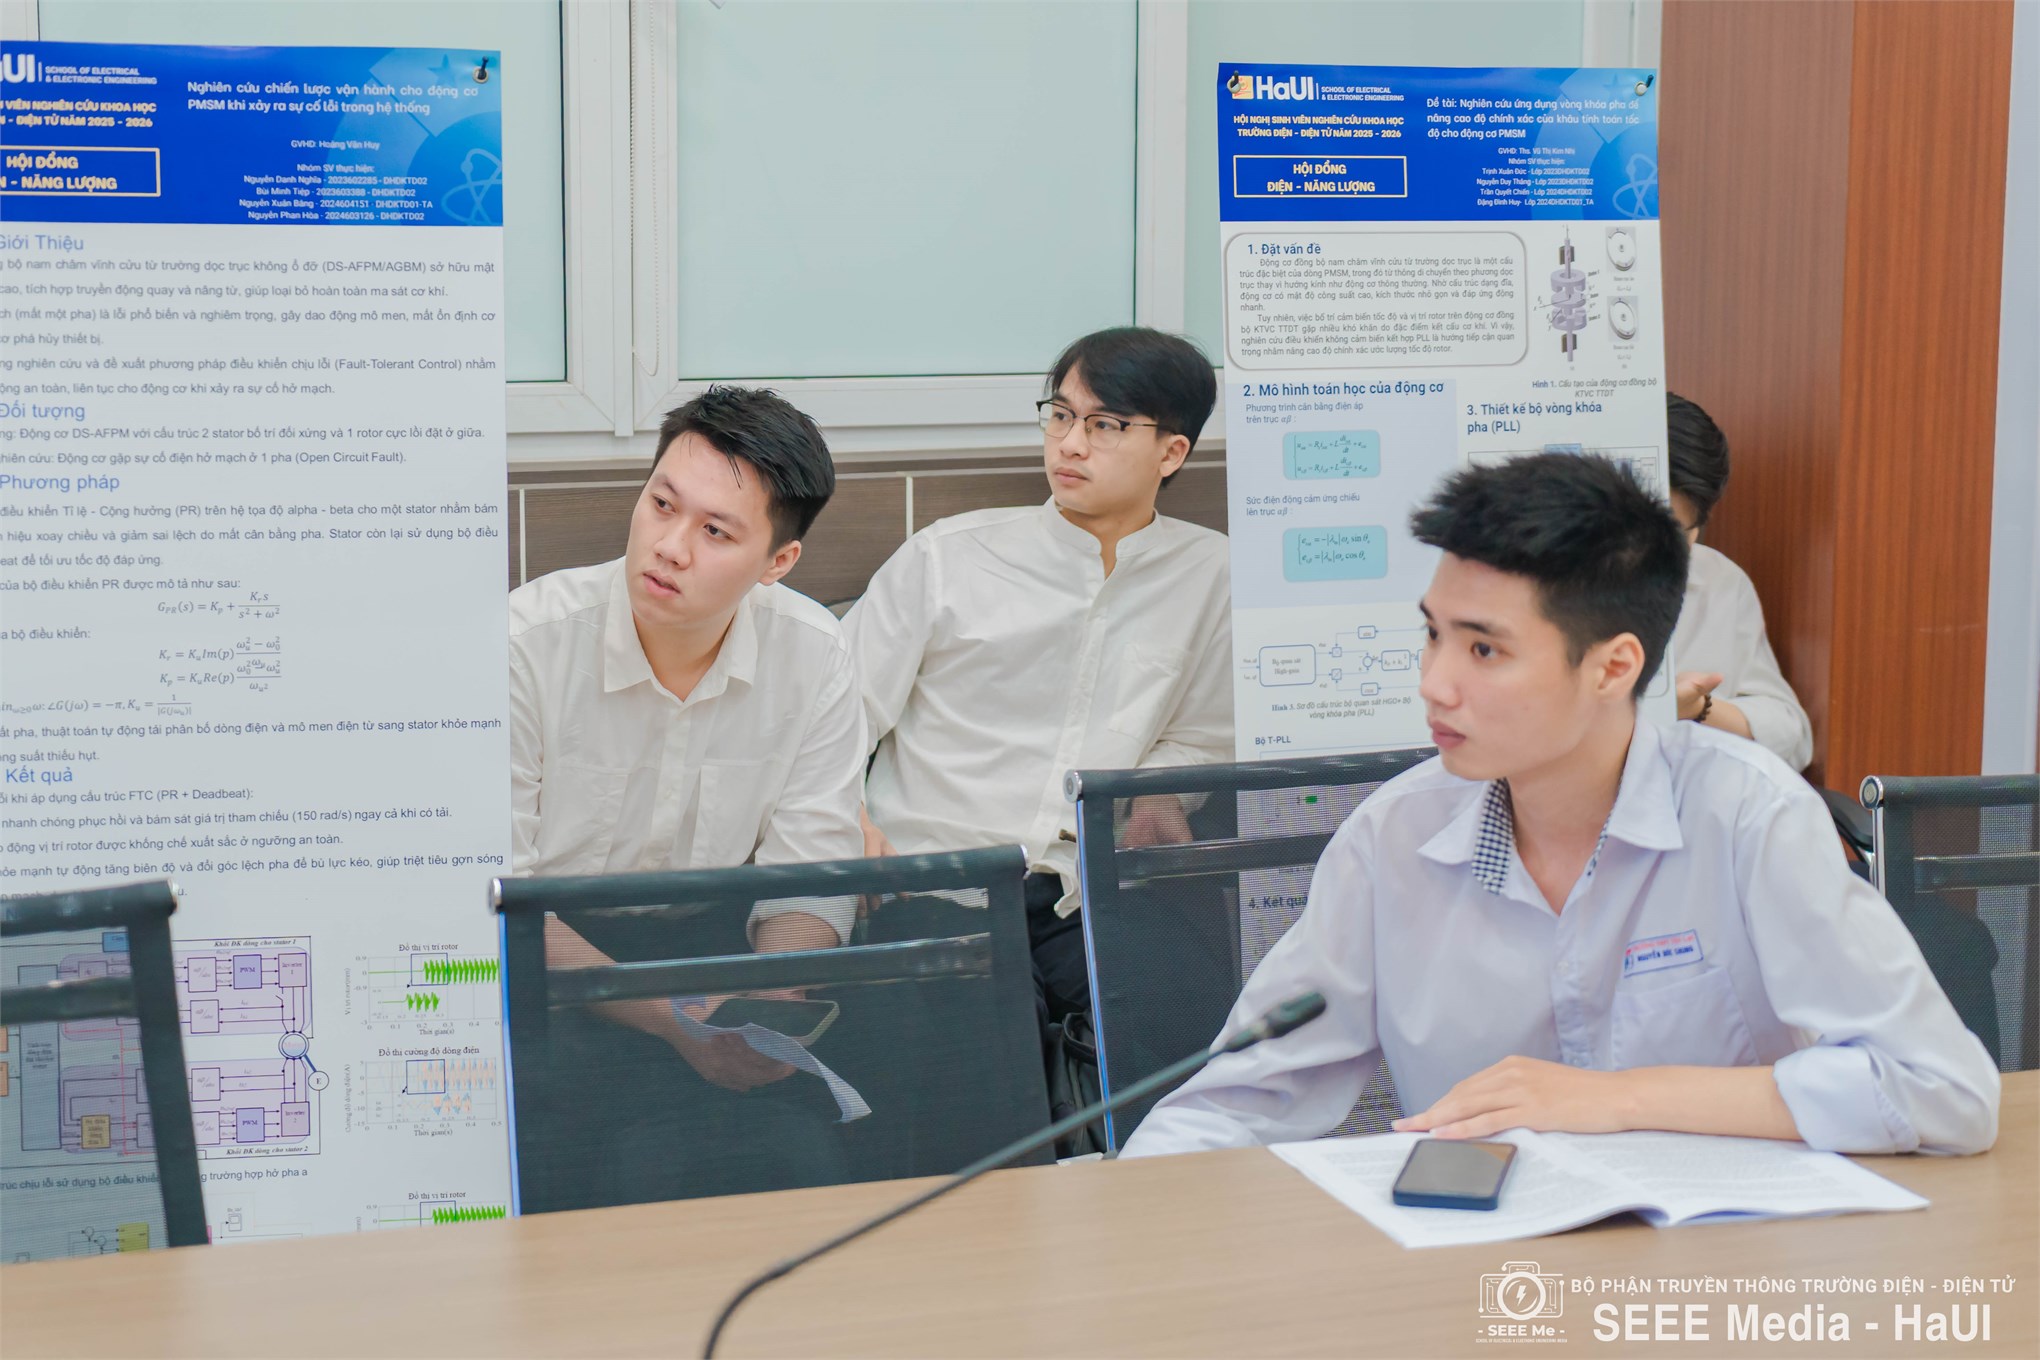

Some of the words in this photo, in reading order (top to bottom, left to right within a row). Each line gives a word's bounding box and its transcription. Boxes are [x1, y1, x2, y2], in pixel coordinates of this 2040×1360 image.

[0, 54, 34, 82] UI
[187, 81, 232, 94] Nghiên
[236, 81, 260, 93] cứu
[264, 80, 299, 93] chiến
[303, 83, 330, 96] lược
[336, 83, 359, 97] vận
[363, 84, 394, 95] hành
[400, 84, 422, 95] cho
[427, 85, 458, 98] động
[463, 87, 478, 96] cơ
[1256, 75, 1313, 100] HaUI
[5, 98, 31, 109] VIÊN
[31, 99, 73, 110] NGHIÊN
[74, 98, 99, 111] CỨU
[99, 102, 131, 112] KHOA
[132, 102, 156, 114] HỌC
[188, 98, 225, 110] PMSM
[227, 99, 245, 110] khi
[248, 99, 270, 113] xảy
[273, 102, 286, 111] ra
[288, 102, 304, 113] sự
[305, 98, 320, 111] cố
[323, 99, 338, 111] lỗi
[341, 102, 374, 114] trong
[376, 101, 392, 114] hệ
[394, 101, 430, 115] thống
[1426, 96, 1439, 107] Đề
[1441, 98, 1456, 107] tài:
[1459, 98, 1492, 110] Nghiên
[1494, 98, 1512, 108] cứu
[1514, 98, 1532, 110] ứng
[1533, 99, 1557, 110] dụng
[1560, 101, 1582, 110] vòng
[1584, 99, 1606, 108] khóa
[1608, 99, 1625, 110] pha
[1628, 98, 1638, 109] để
[16, 113, 42, 127] ĐIỆN
[44, 113, 59, 125] TỬ
[60, 114, 86, 125] NĂM
[87, 116, 115, 126] 2025
[125, 117, 152, 127] 2026
[1233, 114, 1248, 125] HỘI
[1249, 115, 1270, 125] NGHỊ
[1271, 115, 1291, 123] SINH
[1292, 114, 1311, 124] VIÊN
[1312, 114, 1343, 124] NGHIÊN
[1343, 114, 1361, 124] CỨU
[1362, 116, 1385, 124] KHOA
[1386, 116, 1404, 126] HỌC
[1427, 113, 1451, 124] nâng
[1473, 113, 1486, 124] độ
[1488, 113, 1514, 122] chính
[1517, 113, 1534, 123] xác
[1536, 114, 1553, 123] của
[1556, 114, 1578, 123] khâu
[1582, 114, 1599, 123] tính
[1602, 114, 1622, 123] toán
[1625, 113, 1639, 124] tốc
[1237, 126, 1272, 136] TRƯỜNG
[1273, 127, 1292, 138] ĐIỆN
[1300, 127, 1319, 139] ĐIỆN
[1320, 127, 1332, 137] TỬ
[1332, 127, 1352, 137] NĂM
[1353, 129, 1373, 137] 2025
[1381, 129, 1401, 137] 2026
[1427, 128, 1440, 139] độ
[1441, 128, 1459, 137] cho
[1460, 128, 1484, 140] động
[1498, 128, 1526, 138] PMSM
[6, 152, 32, 171] HỘI
[35, 151, 78, 169] ĐỒNG
[1293, 161, 1312, 176] HỘI
[1314, 159, 1346, 174] ĐỒNG
[21, 174, 63, 189] NĂNG
[66, 176, 117, 192] LƯỢNG
[1267, 179, 1293, 194] ĐIỆN
[1304, 179, 1335, 192] NĂNG
[1337, 180, 1376, 195] LƯỢNG
[0, 234, 28, 249] Giới
[34, 234, 83, 252] Thiệu
[1248, 244, 1257, 254] 1.
[1261, 243, 1280, 256] Đặt
[1283, 244, 1303, 254] vấn
[1306, 243, 1320, 254] đề
[1243, 384, 1254, 396] 2.
[1259, 383, 1278, 396] Mô
[1282, 383, 1309, 395] hình
[1312, 382, 1340, 395] toán
[1343, 382, 1365, 396] học
[1369, 381, 1390, 393] của
[1394, 381, 1425, 395] động
[1429, 383, 1443, 392] cơ
[0, 400, 25, 418] Đối
[32, 404, 85, 420] tượng
[1467, 404, 1477, 415] 3.
[1480, 403, 1509, 414] Thiết
[1512, 403, 1525, 414] kế
[1528, 402, 1542, 415] bộ
[1545, 402, 1572, 415] vòng
[1575, 401, 1601, 412] khóa
[1467, 420, 1487, 435] pha
[1491, 420, 1520, 434] (PLL)
[0, 474, 70, 493] Phương
[77, 474, 119, 492] pháp
[1255, 737, 1265, 745] Bộ
[1268, 735, 1291, 744] T-PLL
[6, 764, 34, 783] Kết
[40, 766, 72, 785] quả
[11, 793, 27, 803] khi
[30, 793, 45, 804] áp
[48, 793, 76, 804] dụng
[80, 790, 100, 801] cấu
[104, 791, 126, 801] trúc
[129, 790, 153, 800] FTC
[156, 789, 178, 801] (PR
[192, 788, 253, 800] Deadbeat):
